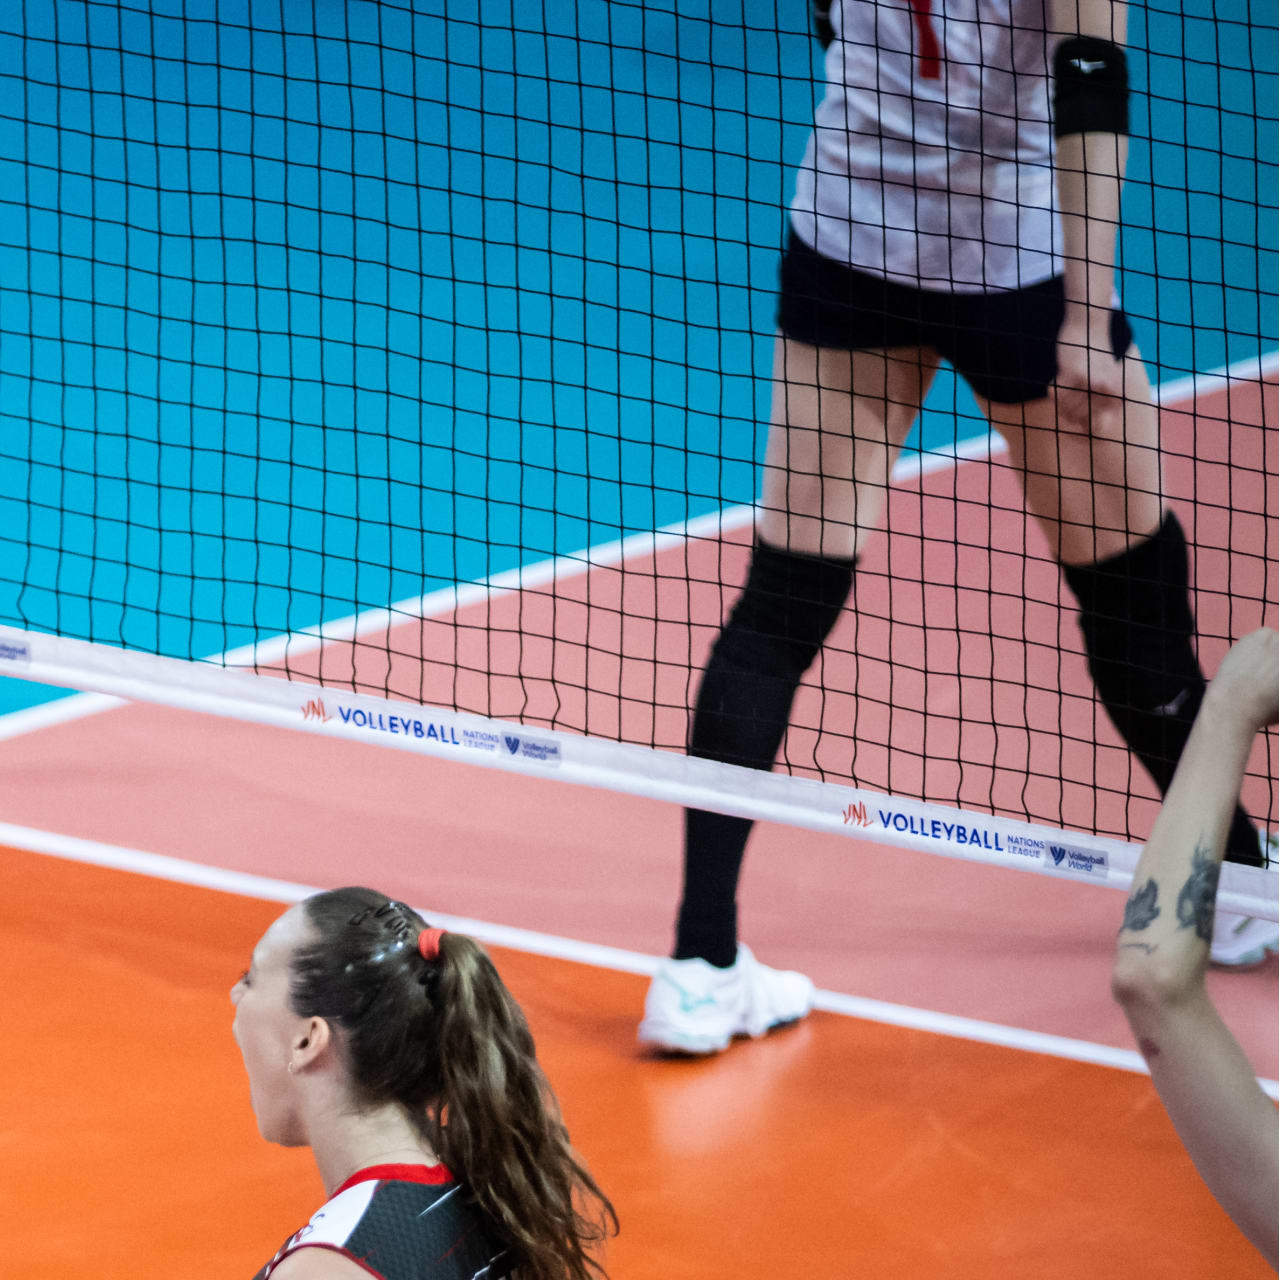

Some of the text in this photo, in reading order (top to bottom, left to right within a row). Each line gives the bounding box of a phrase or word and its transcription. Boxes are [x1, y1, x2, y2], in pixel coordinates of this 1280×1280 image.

[339, 706, 460, 745] VOLLEYBALL
[878, 809, 1004, 852] VOLLEYBALL
[1007, 834, 1045, 849] NATIONS
[1007, 845, 1040, 859] LEAGUE
[1068, 850, 1105, 866] Volleyball
